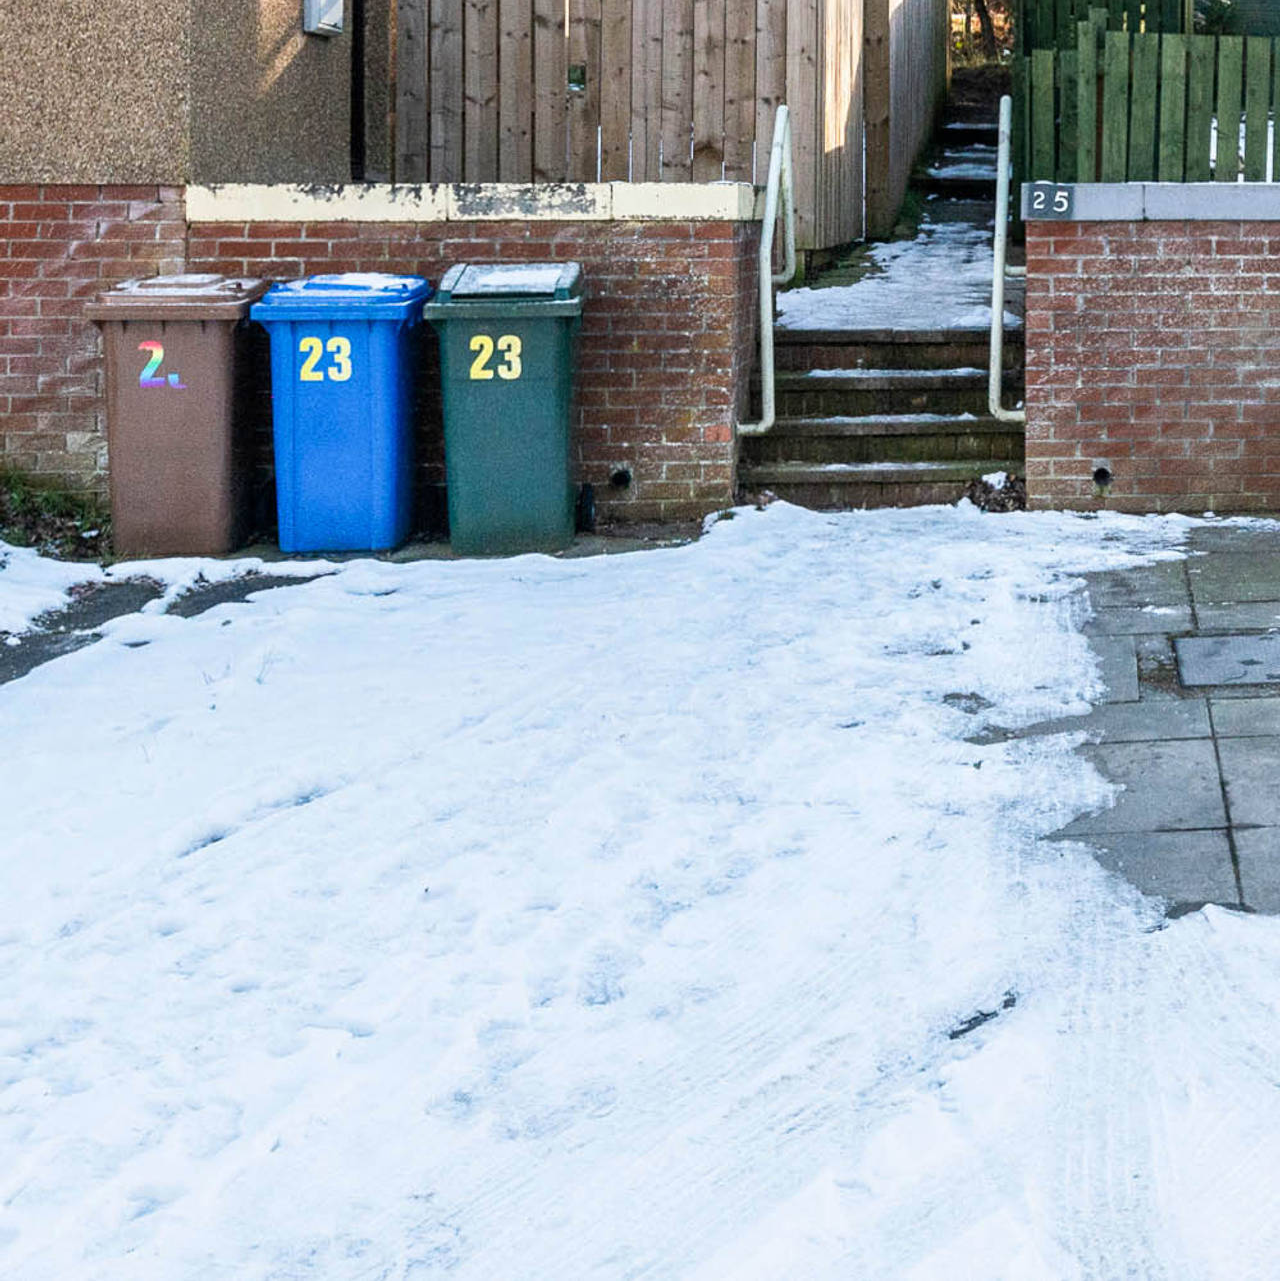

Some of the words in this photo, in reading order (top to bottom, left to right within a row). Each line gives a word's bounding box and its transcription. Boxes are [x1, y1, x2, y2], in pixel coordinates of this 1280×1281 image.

[1033, 191, 1069, 213] 25
[137, 340, 187, 388] 2
[299, 336, 352, 381] 23
[469, 334, 522, 380] 23
